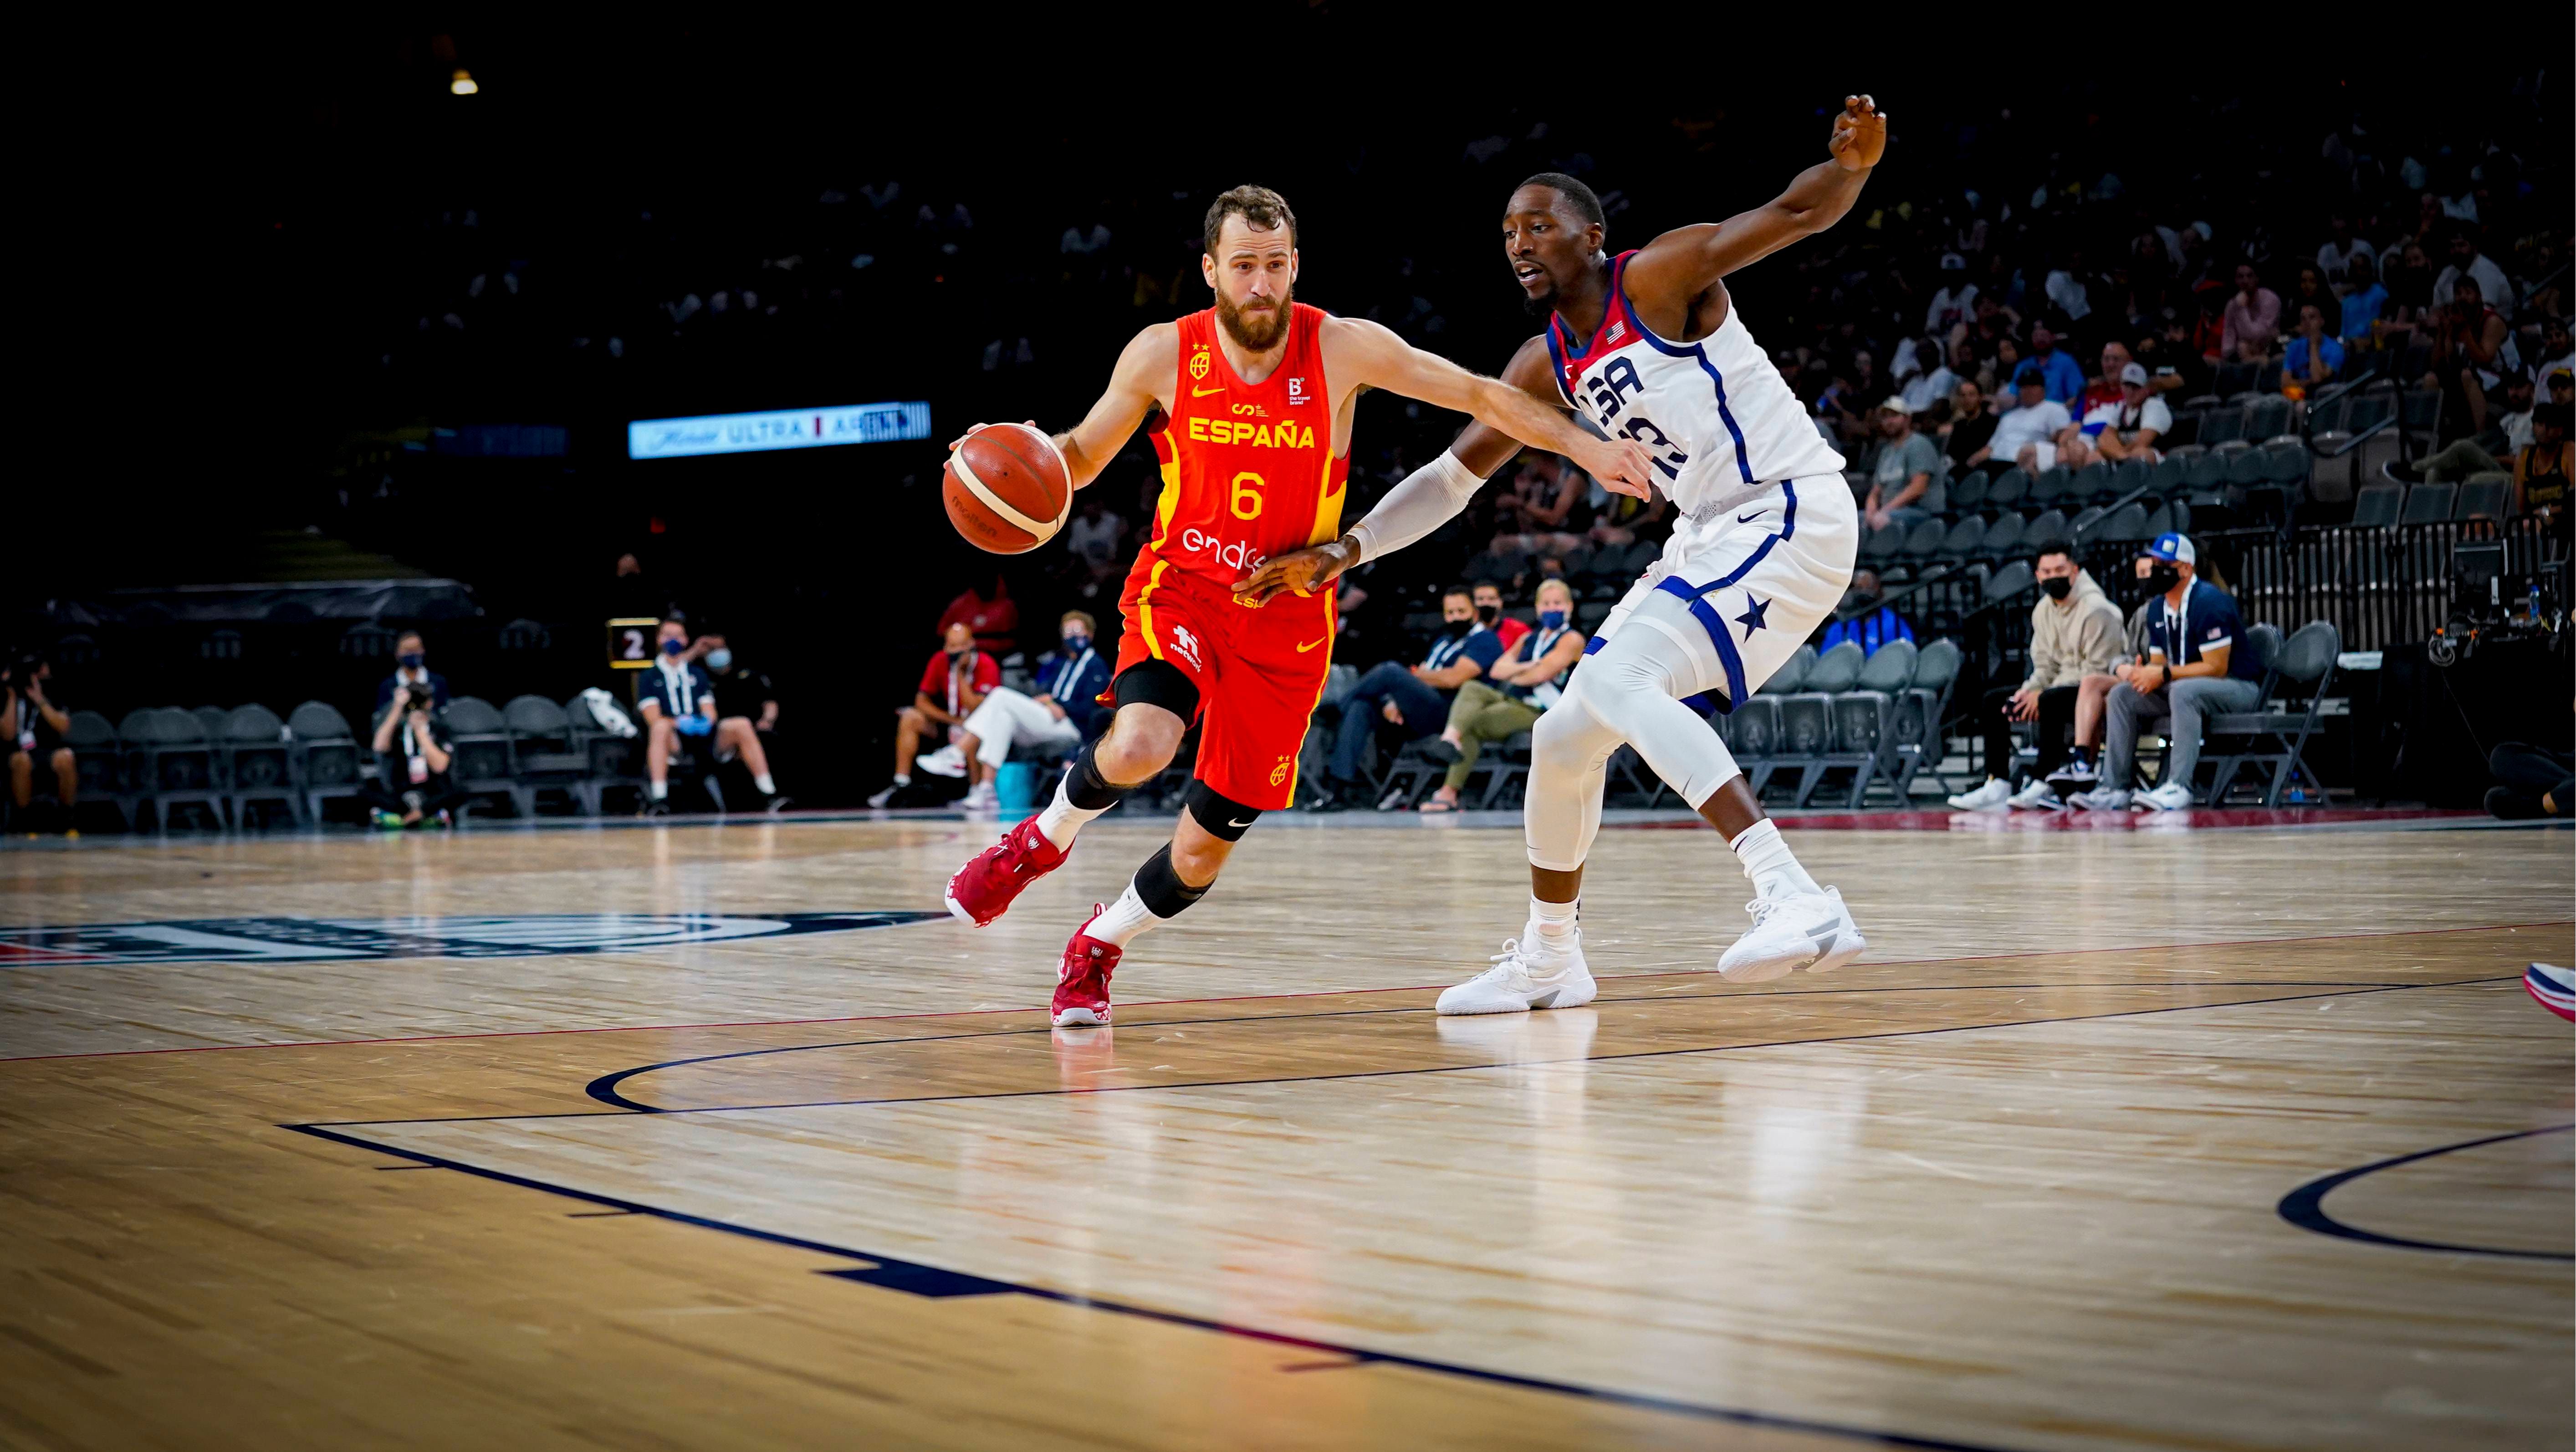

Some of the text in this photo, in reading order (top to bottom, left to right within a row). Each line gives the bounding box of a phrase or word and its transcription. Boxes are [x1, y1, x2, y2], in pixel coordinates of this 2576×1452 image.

[727, 418, 806, 445] ULTRA
[1189, 417, 1315, 449] ESPAÑA
[1231, 471, 1265, 521] 6
[622, 629, 646, 660] 2
